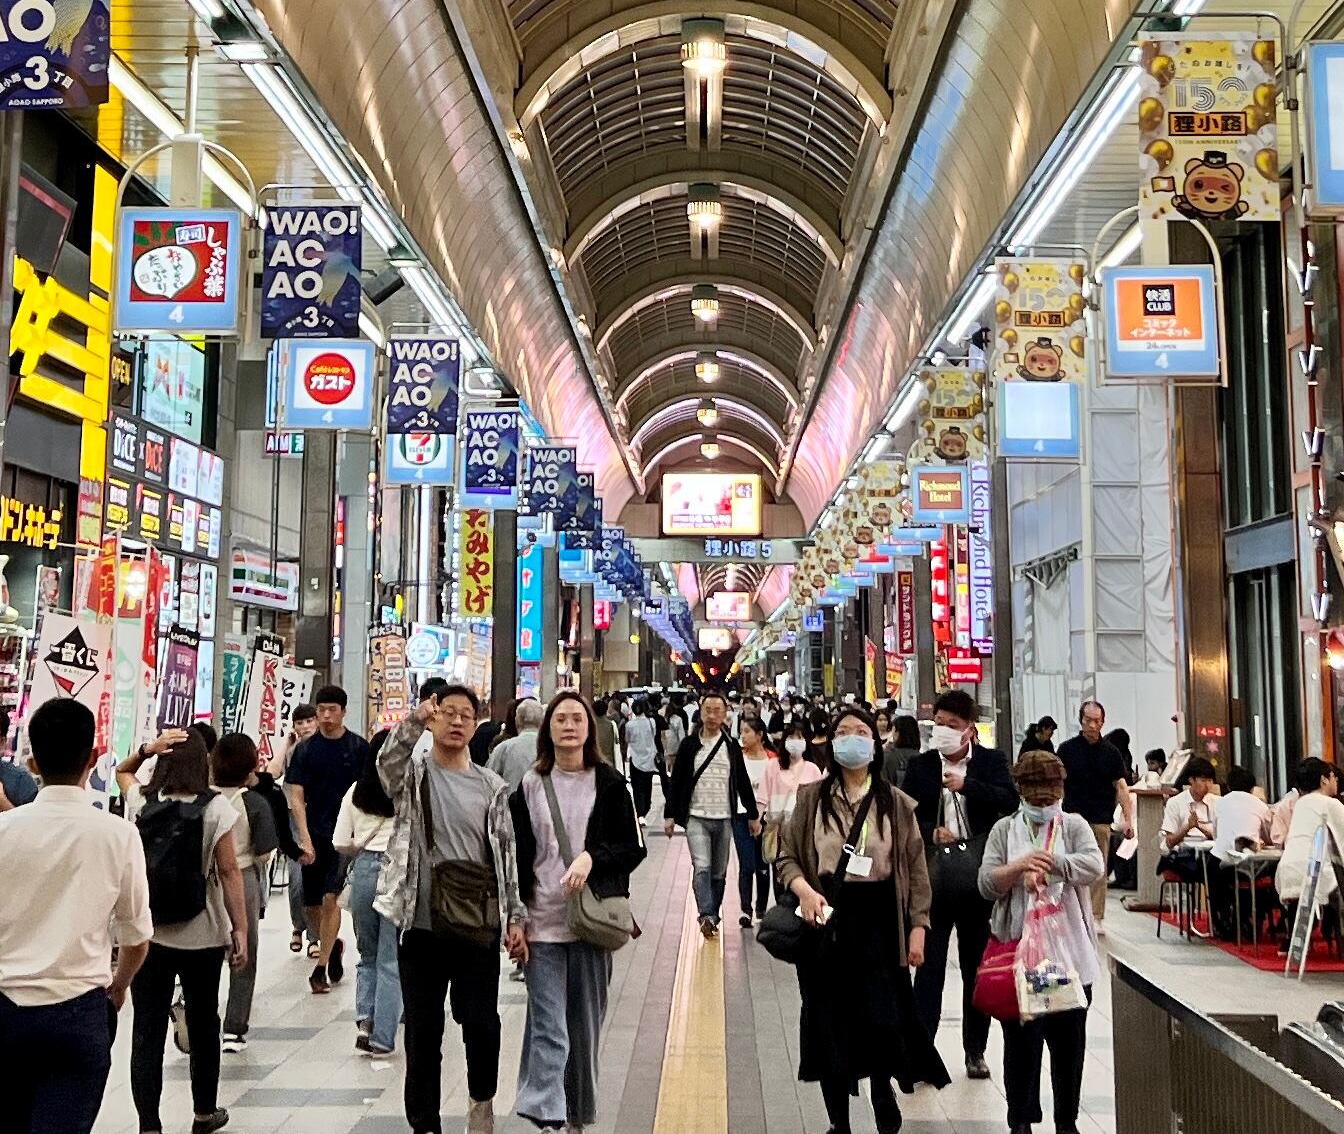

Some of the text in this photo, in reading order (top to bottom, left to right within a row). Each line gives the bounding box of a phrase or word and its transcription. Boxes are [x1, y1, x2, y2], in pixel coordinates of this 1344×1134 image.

[1174, 114, 1242, 133] 狸小路
[269, 210, 358, 236] WAO!
[203, 226, 227, 298] しゃぶ葉
[268, 238, 325, 268] AC
[267, 269, 324, 300] AO
[167, 305, 185, 324] 4
[1146, 302, 1172, 313] CLUB
[391, 341, 458, 361] WAO!
[1155, 353, 1169, 369] 4
[309, 374, 353, 391] ガスト
[392, 363, 434, 385] AC
[391, 385, 433, 408] AO
[322, 410, 334, 423] 4
[469, 413, 518, 430] WAO!
[468, 430, 499, 448] AC
[1033, 439, 1045, 452] 4
[468, 448, 499, 466] AO
[532, 449, 576, 463] WAO!
[414, 467, 424, 479] 4
[532, 464, 560, 478] AC
[531, 479, 559, 494] AO
[704, 540, 772, 558] 狸小路 5
